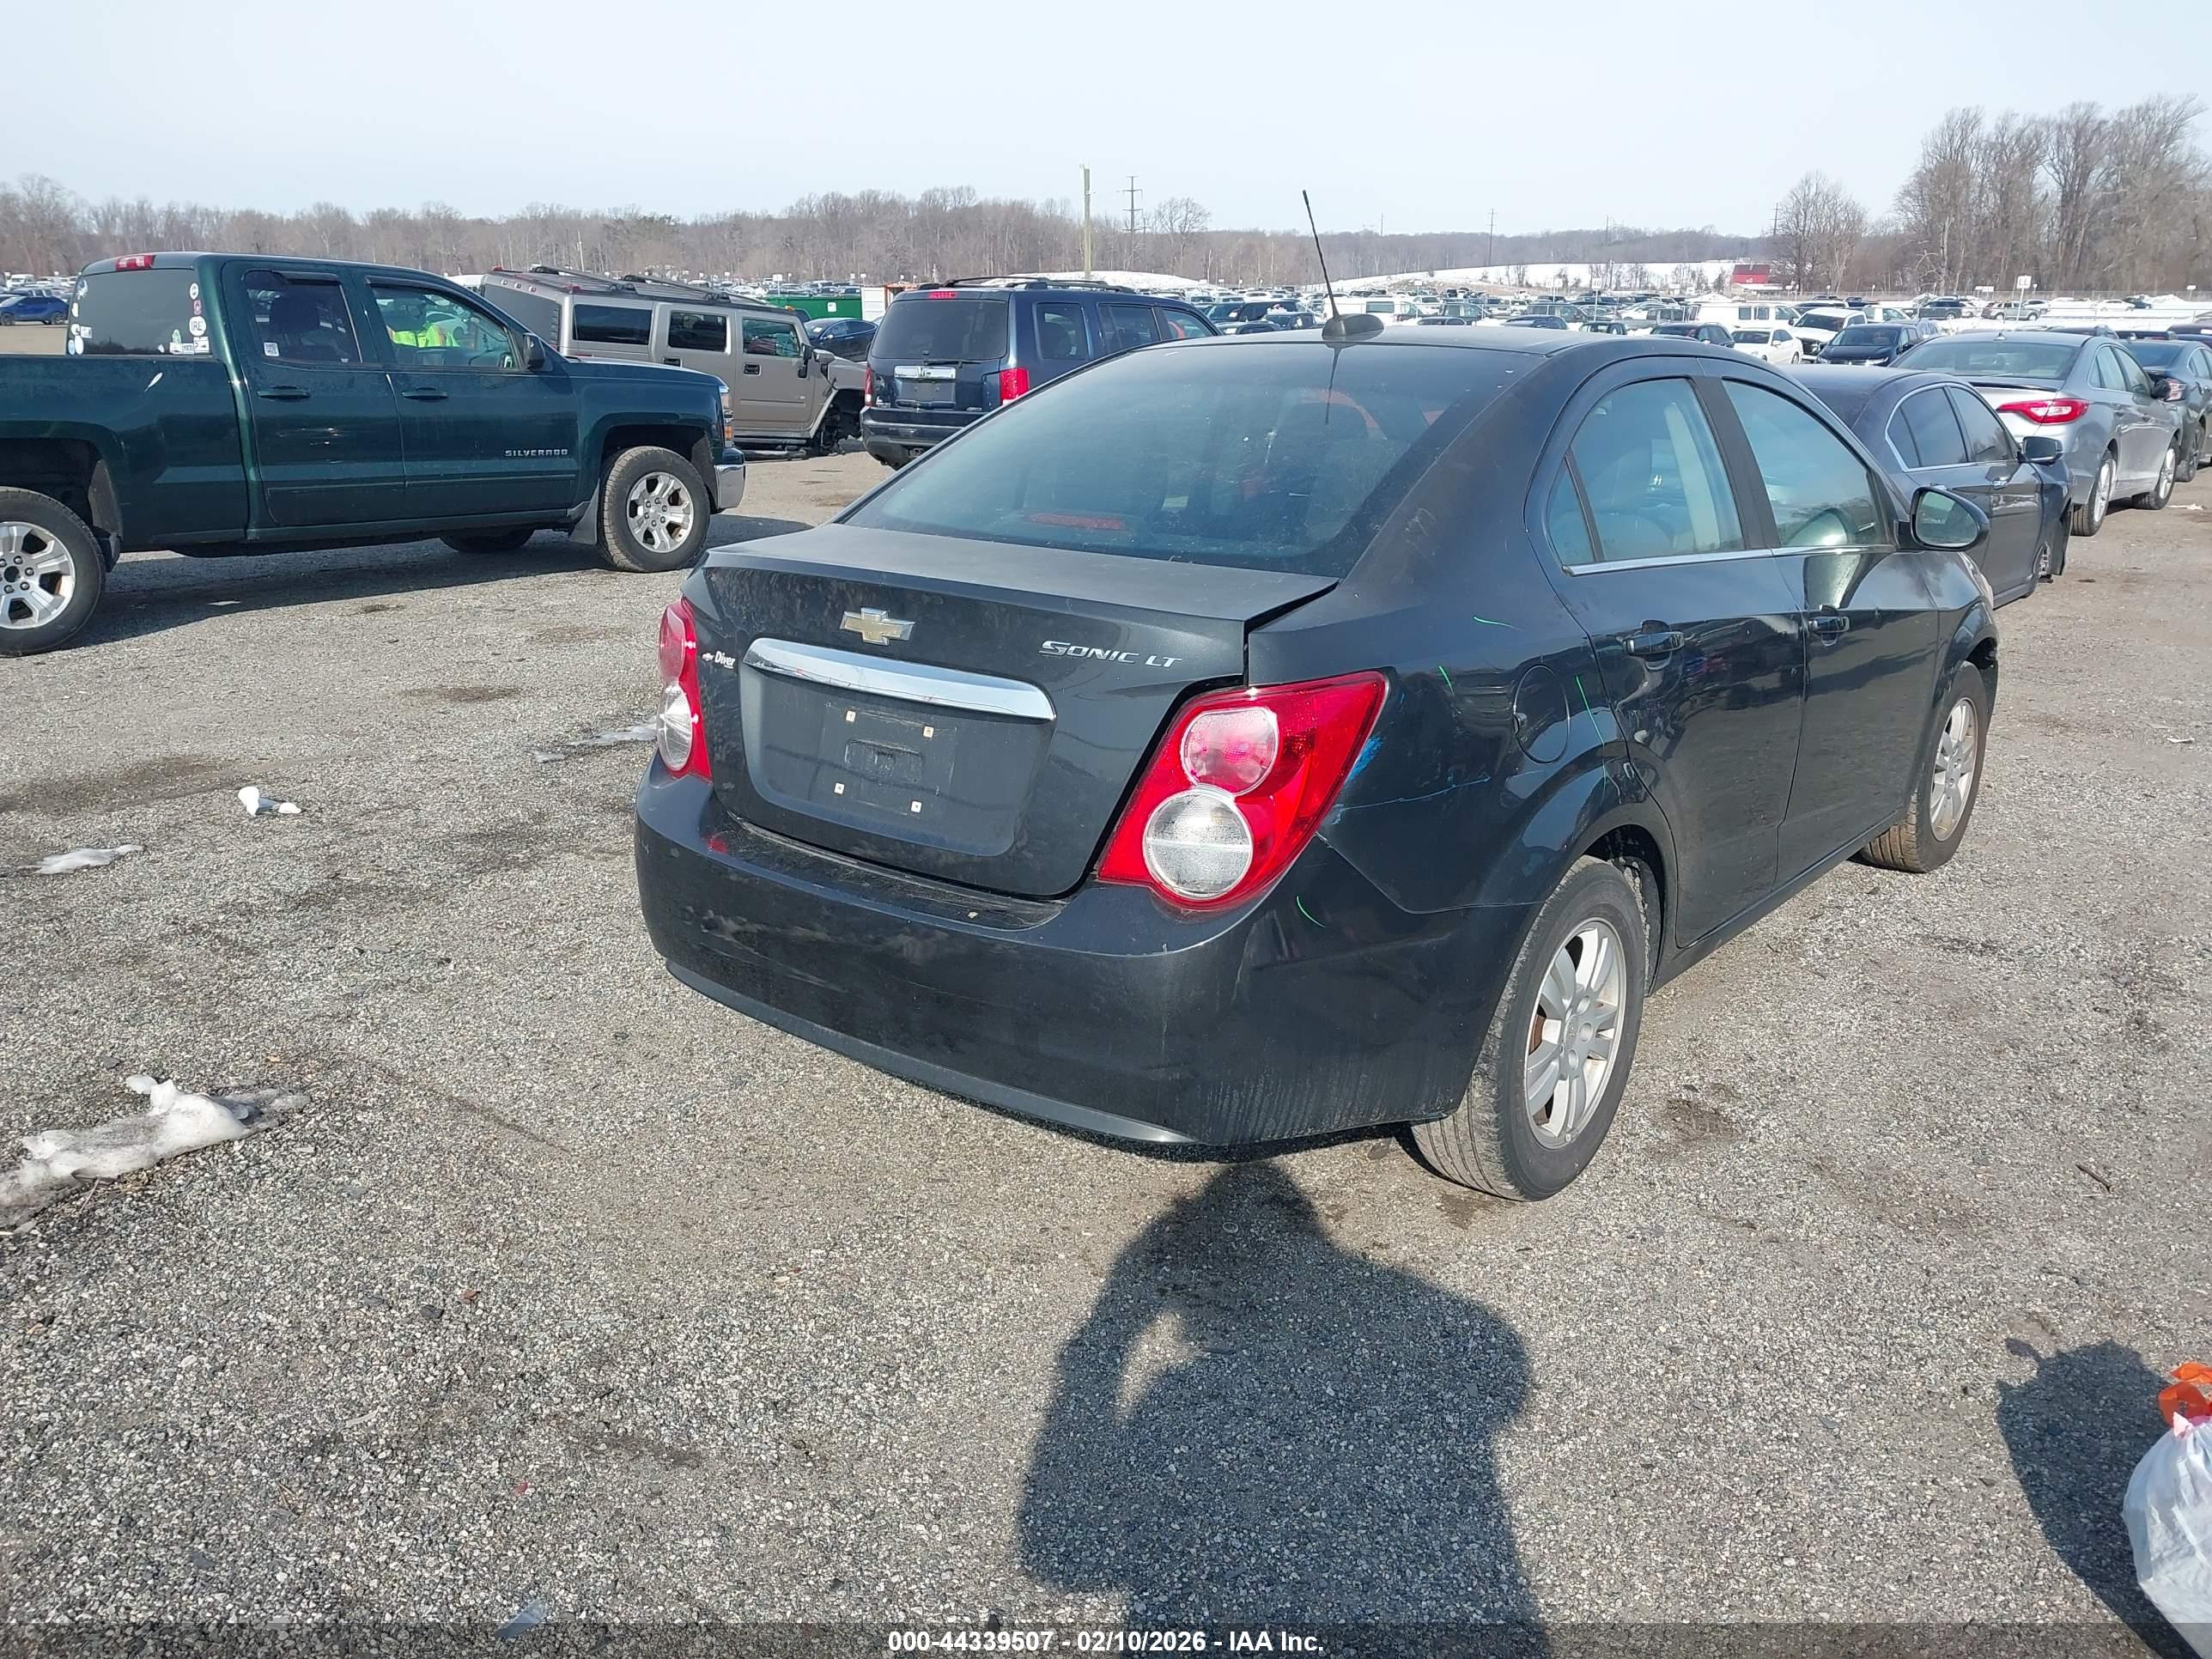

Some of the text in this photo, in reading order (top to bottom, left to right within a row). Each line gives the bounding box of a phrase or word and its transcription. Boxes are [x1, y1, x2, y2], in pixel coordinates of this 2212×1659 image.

[504, 448, 568, 457] SILVERADO
[714, 650, 736, 667] Diver
[1038, 640, 1182, 668] SONIC LT
